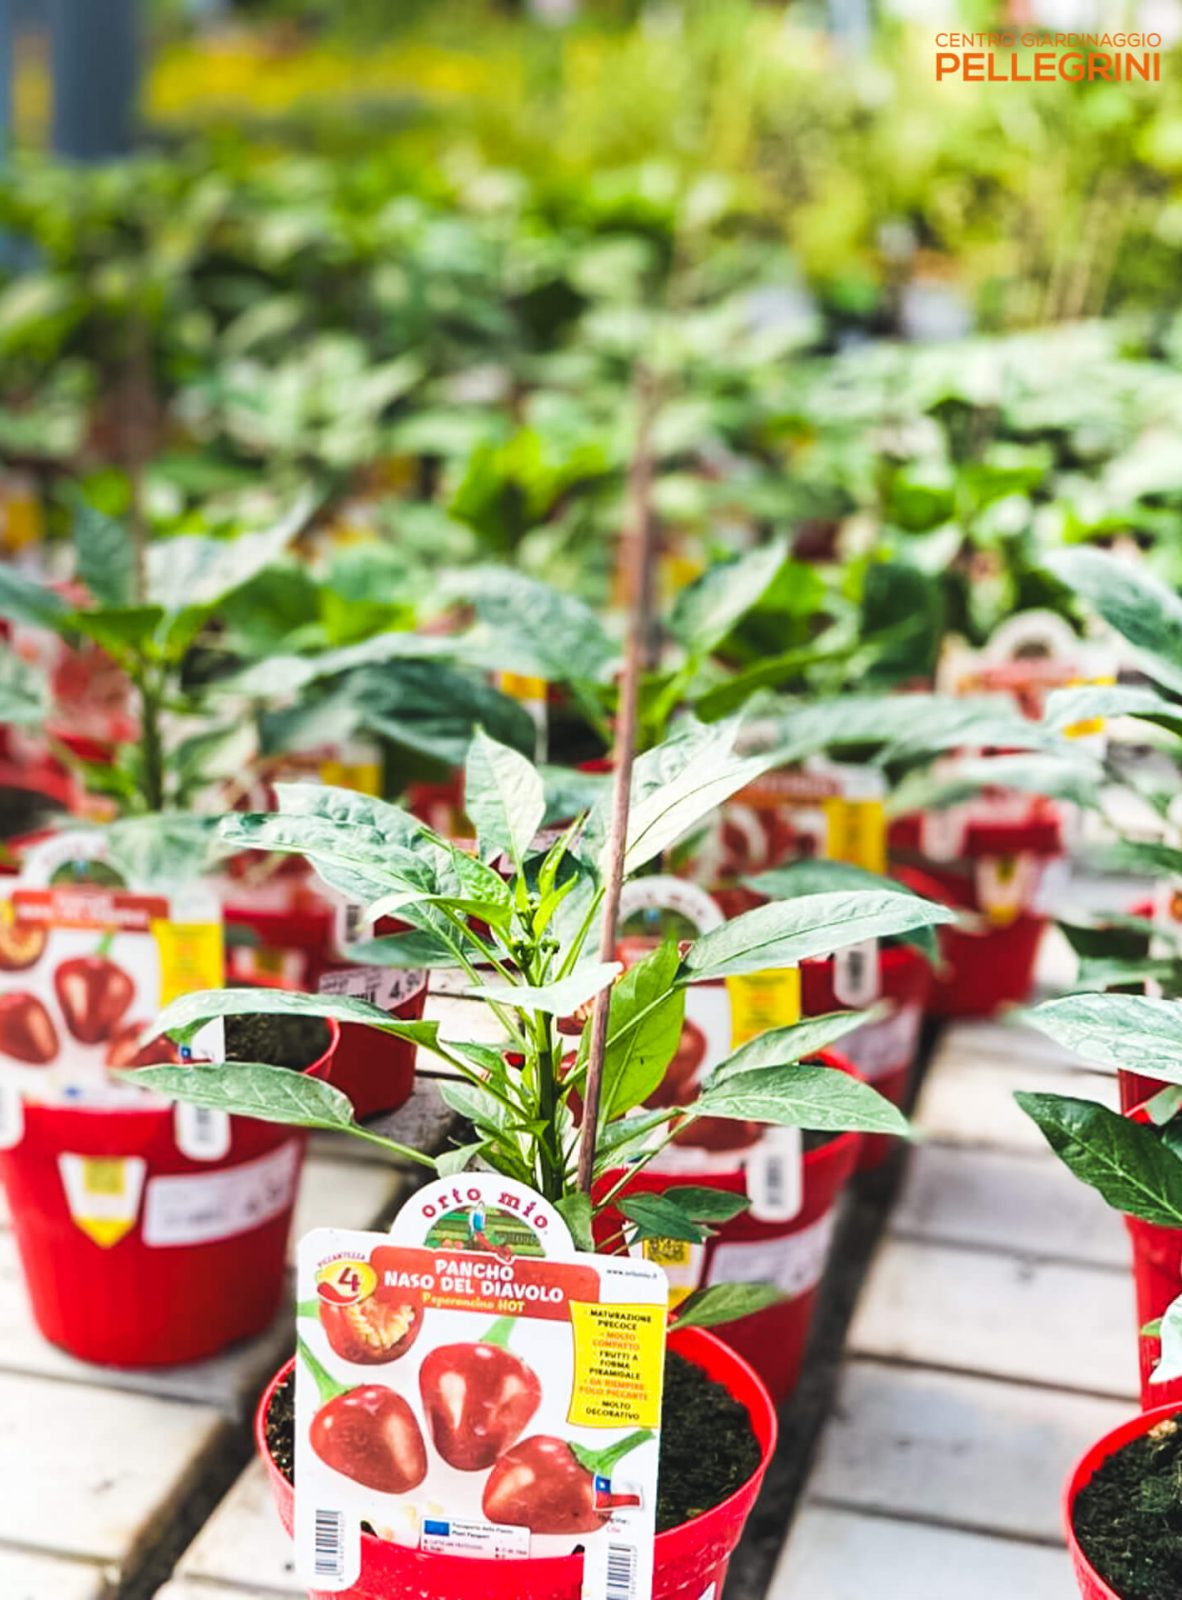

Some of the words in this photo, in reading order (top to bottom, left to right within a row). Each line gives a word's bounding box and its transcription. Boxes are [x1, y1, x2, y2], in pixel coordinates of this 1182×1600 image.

[422, 1188, 481, 1218] orto
[498, 1192, 548, 1228] mio
[434, 1259, 514, 1281] PANCHO
[338, 1266, 361, 1292] 4
[384, 1270, 434, 1290] NASO
[441, 1276, 475, 1295] DEL
[481, 1280, 564, 1303] DIAVOLO
[422, 1291, 494, 1310] Peperoncino
[497, 1300, 526, 1313] HOT
[590, 1310, 652, 1323] MATURAZIONE
[598, 1320, 637, 1330] PRECOCE
[589, 1368, 641, 1380] PIRAMIDALE
[585, 1407, 640, 1420] DECORATIVO
[602, 1400, 632, 1410] MOLTO
